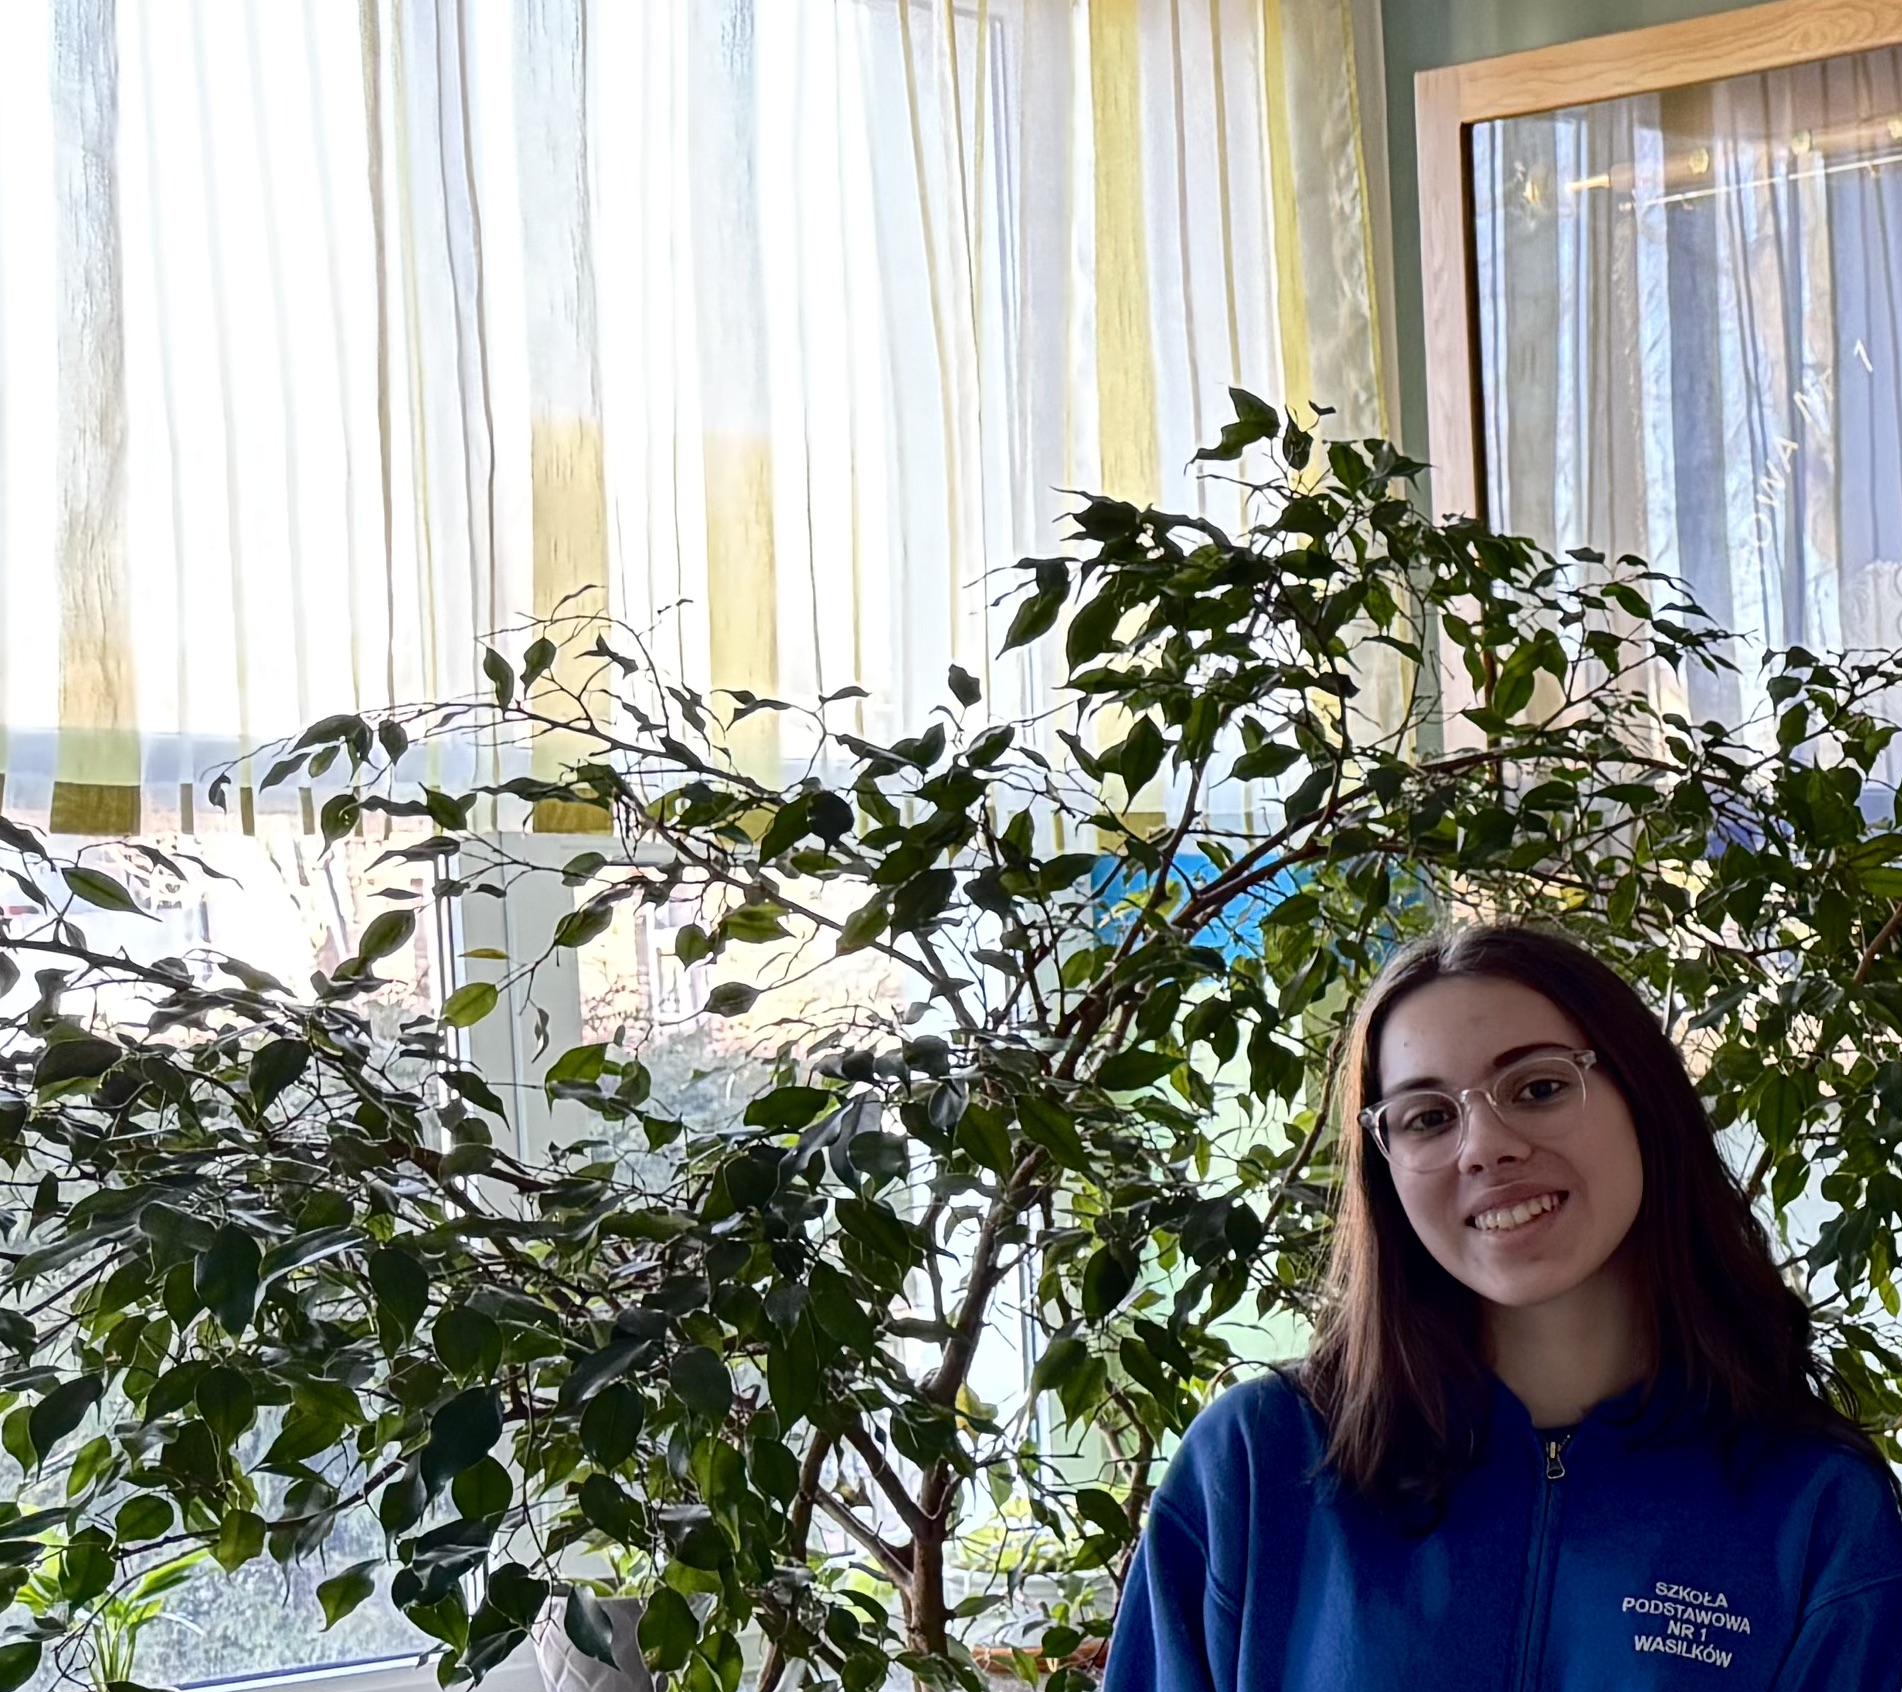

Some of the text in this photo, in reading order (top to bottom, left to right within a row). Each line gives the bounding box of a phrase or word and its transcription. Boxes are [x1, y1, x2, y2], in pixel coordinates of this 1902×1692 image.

[1655, 1581, 1728, 1608] SZKOŁA
[1622, 1597, 1750, 1634] PODSTAWOWA
[1667, 1619, 1706, 1641] NR 1
[1634, 1635, 1732, 1668] WASILKÓW
